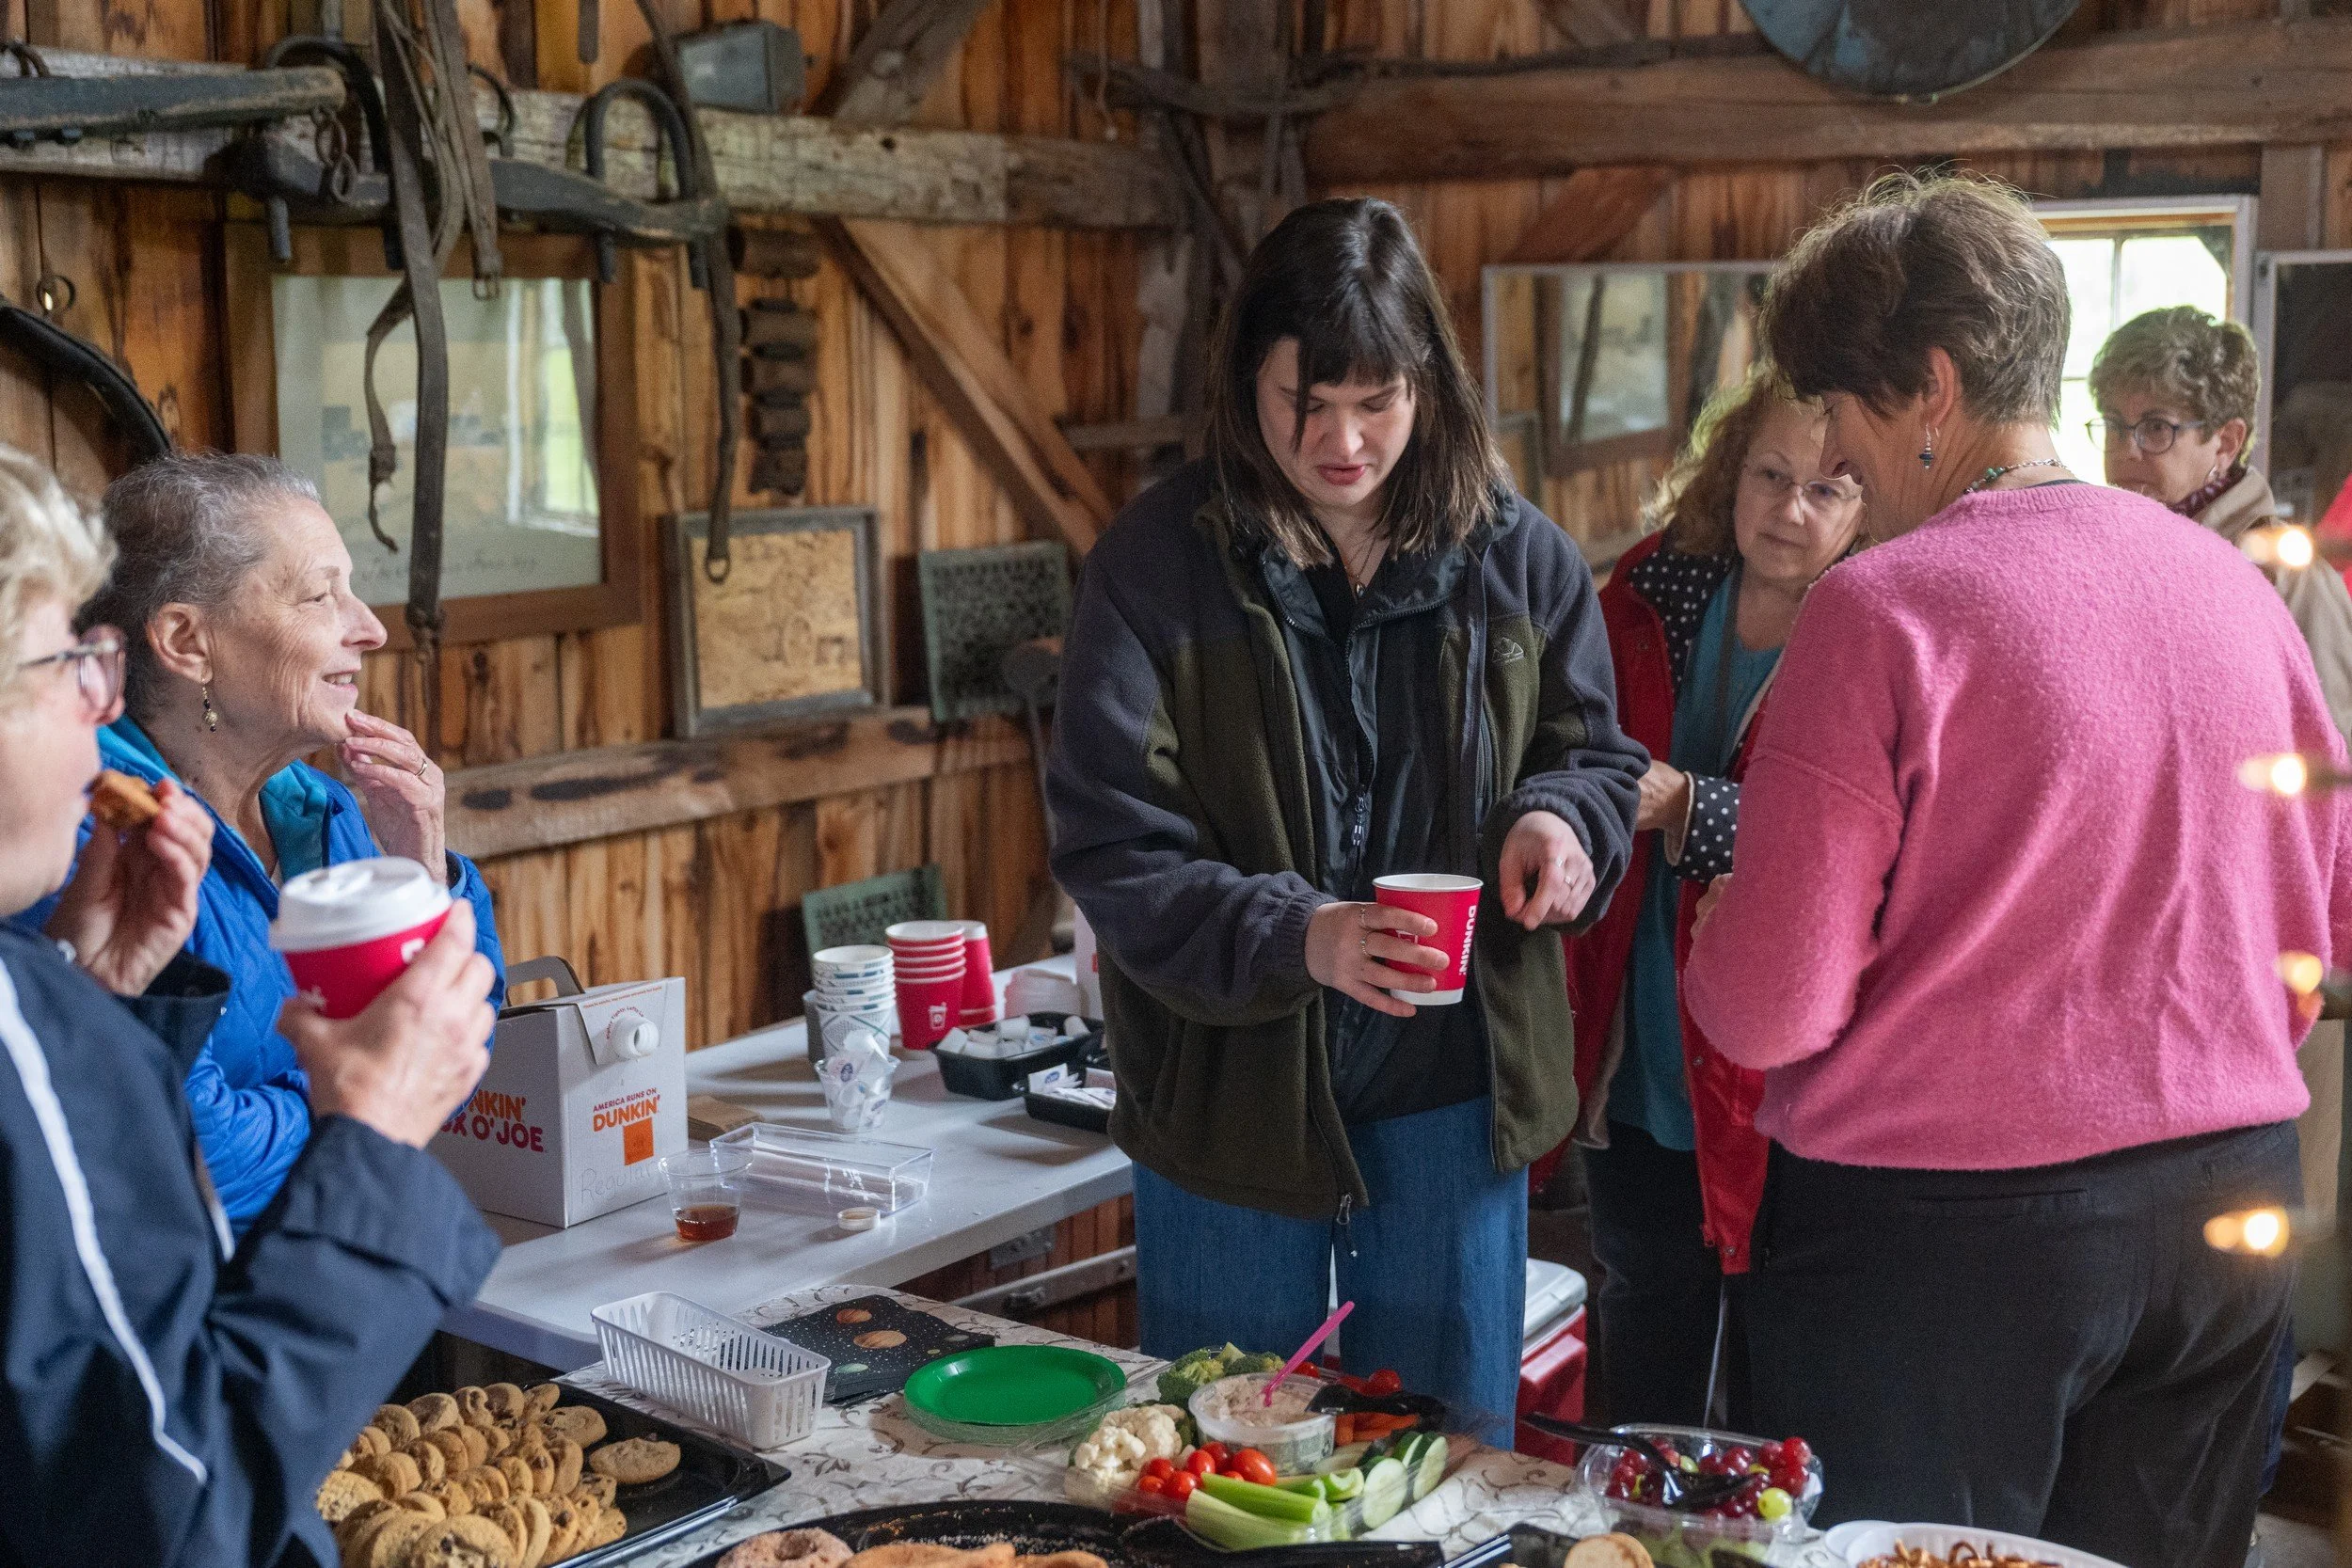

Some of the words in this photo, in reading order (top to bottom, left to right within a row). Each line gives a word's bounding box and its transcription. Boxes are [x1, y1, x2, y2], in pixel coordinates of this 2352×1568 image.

[1458, 905, 1477, 976] DUNKIN'
[469, 1089, 526, 1122] NKIN'
[593, 1097, 625, 1112] AMERICA
[627, 1091, 644, 1102] RUNS
[646, 1087, 657, 1097] ON
[593, 1094, 660, 1132] DUNKIN'
[496, 1120, 544, 1152] JOE
